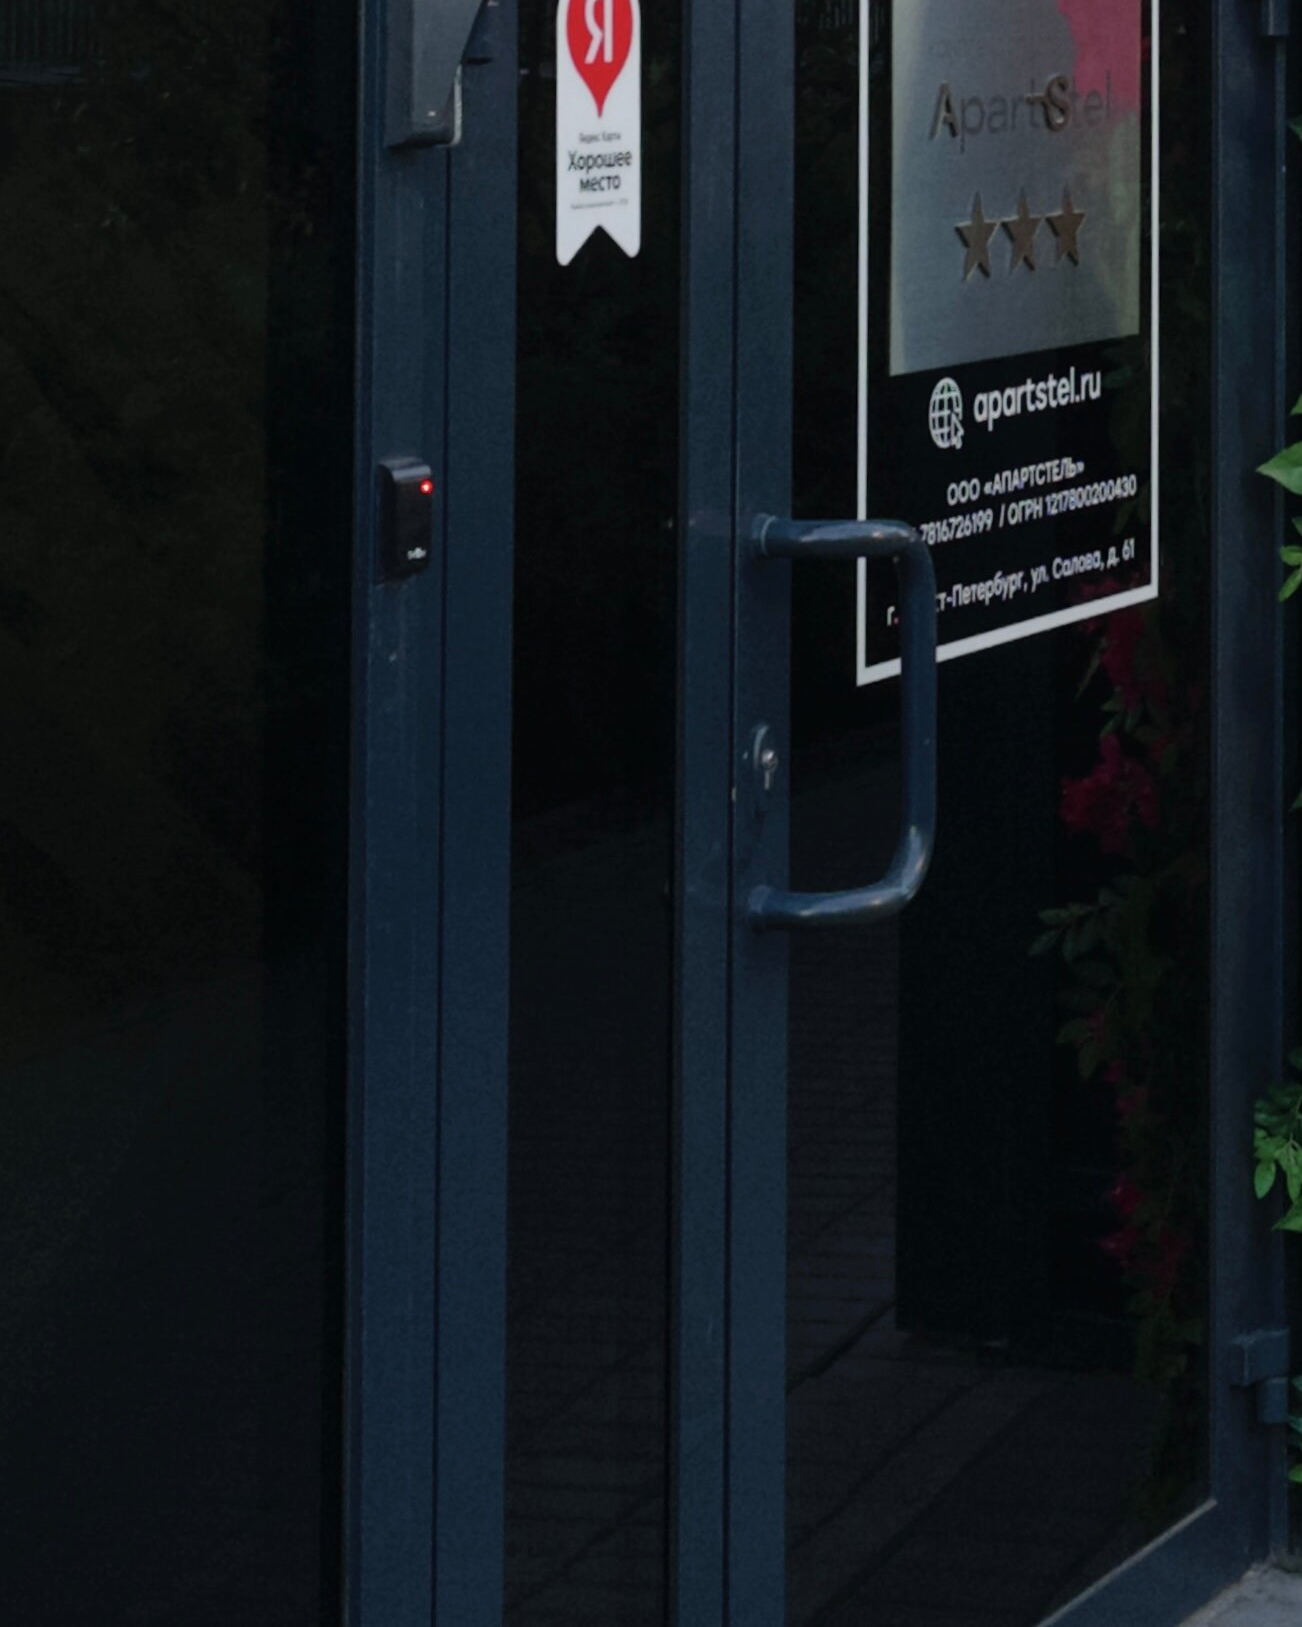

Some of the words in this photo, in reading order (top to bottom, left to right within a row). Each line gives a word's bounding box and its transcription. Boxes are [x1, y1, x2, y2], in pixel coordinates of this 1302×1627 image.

[927, 70, 1112, 154] ApartStel
[567, 150, 632, 174] Хорошее
[578, 175, 621, 192] место
[973, 366, 1102, 431] apartstel.ru
[946, 479, 980, 506] ООО
[983, 456, 1085, 496] «АПАРТСТЕЛЬ»
[1007, 496, 1043, 526] ОГРН
[1030, 564, 1050, 593] ул.
[1052, 549, 1104, 580] Салова,
[1105, 544, 1121, 570] д.
[1121, 536, 1136, 561] 61
